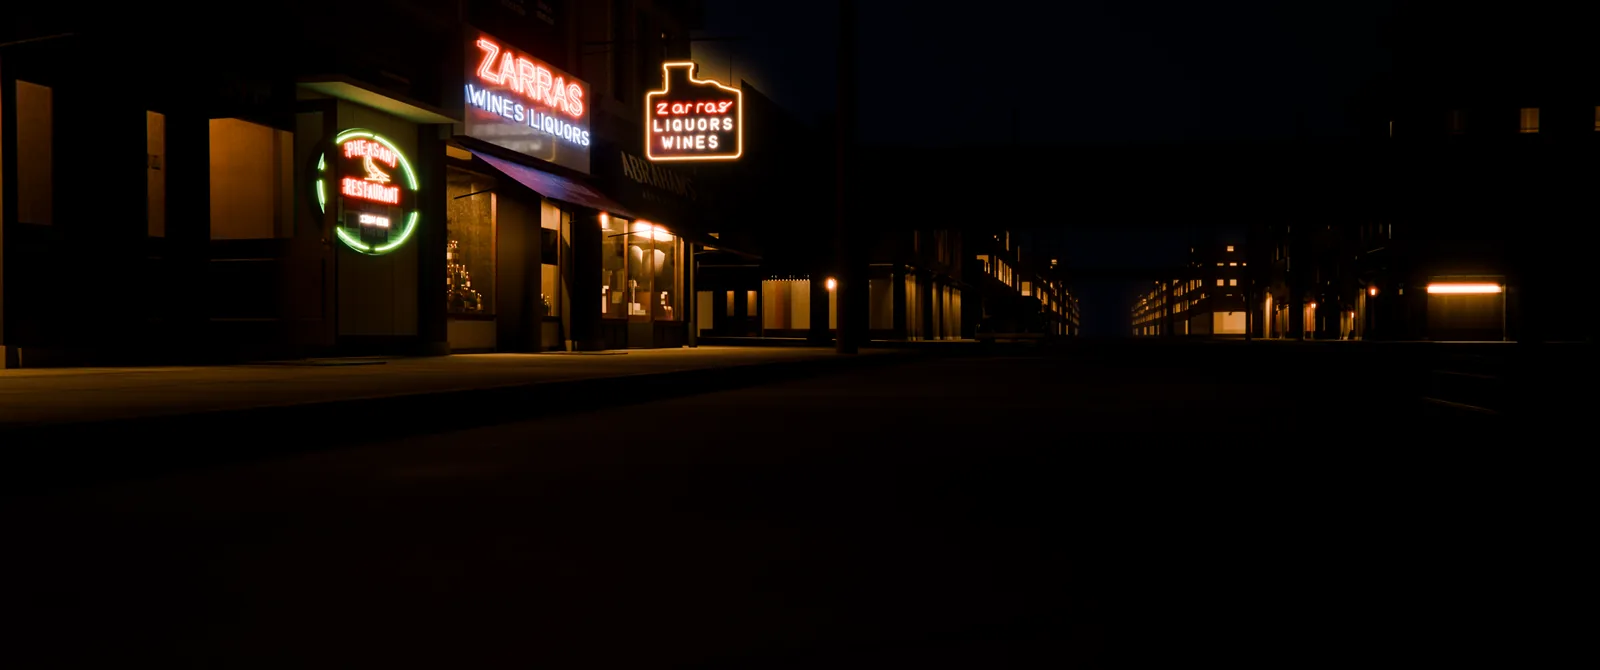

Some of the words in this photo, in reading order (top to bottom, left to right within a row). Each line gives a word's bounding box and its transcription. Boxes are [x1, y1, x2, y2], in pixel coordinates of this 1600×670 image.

[477, 39, 583, 117] ZARRAS
[465, 84, 524, 122] WINES
[527, 108, 590, 146] LIQUORS
[653, 117, 733, 132] LIQUORS
[344, 140, 398, 168] PHEASANT
[662, 135, 719, 149] WINES
[342, 178, 399, 204] RESTAURANT
